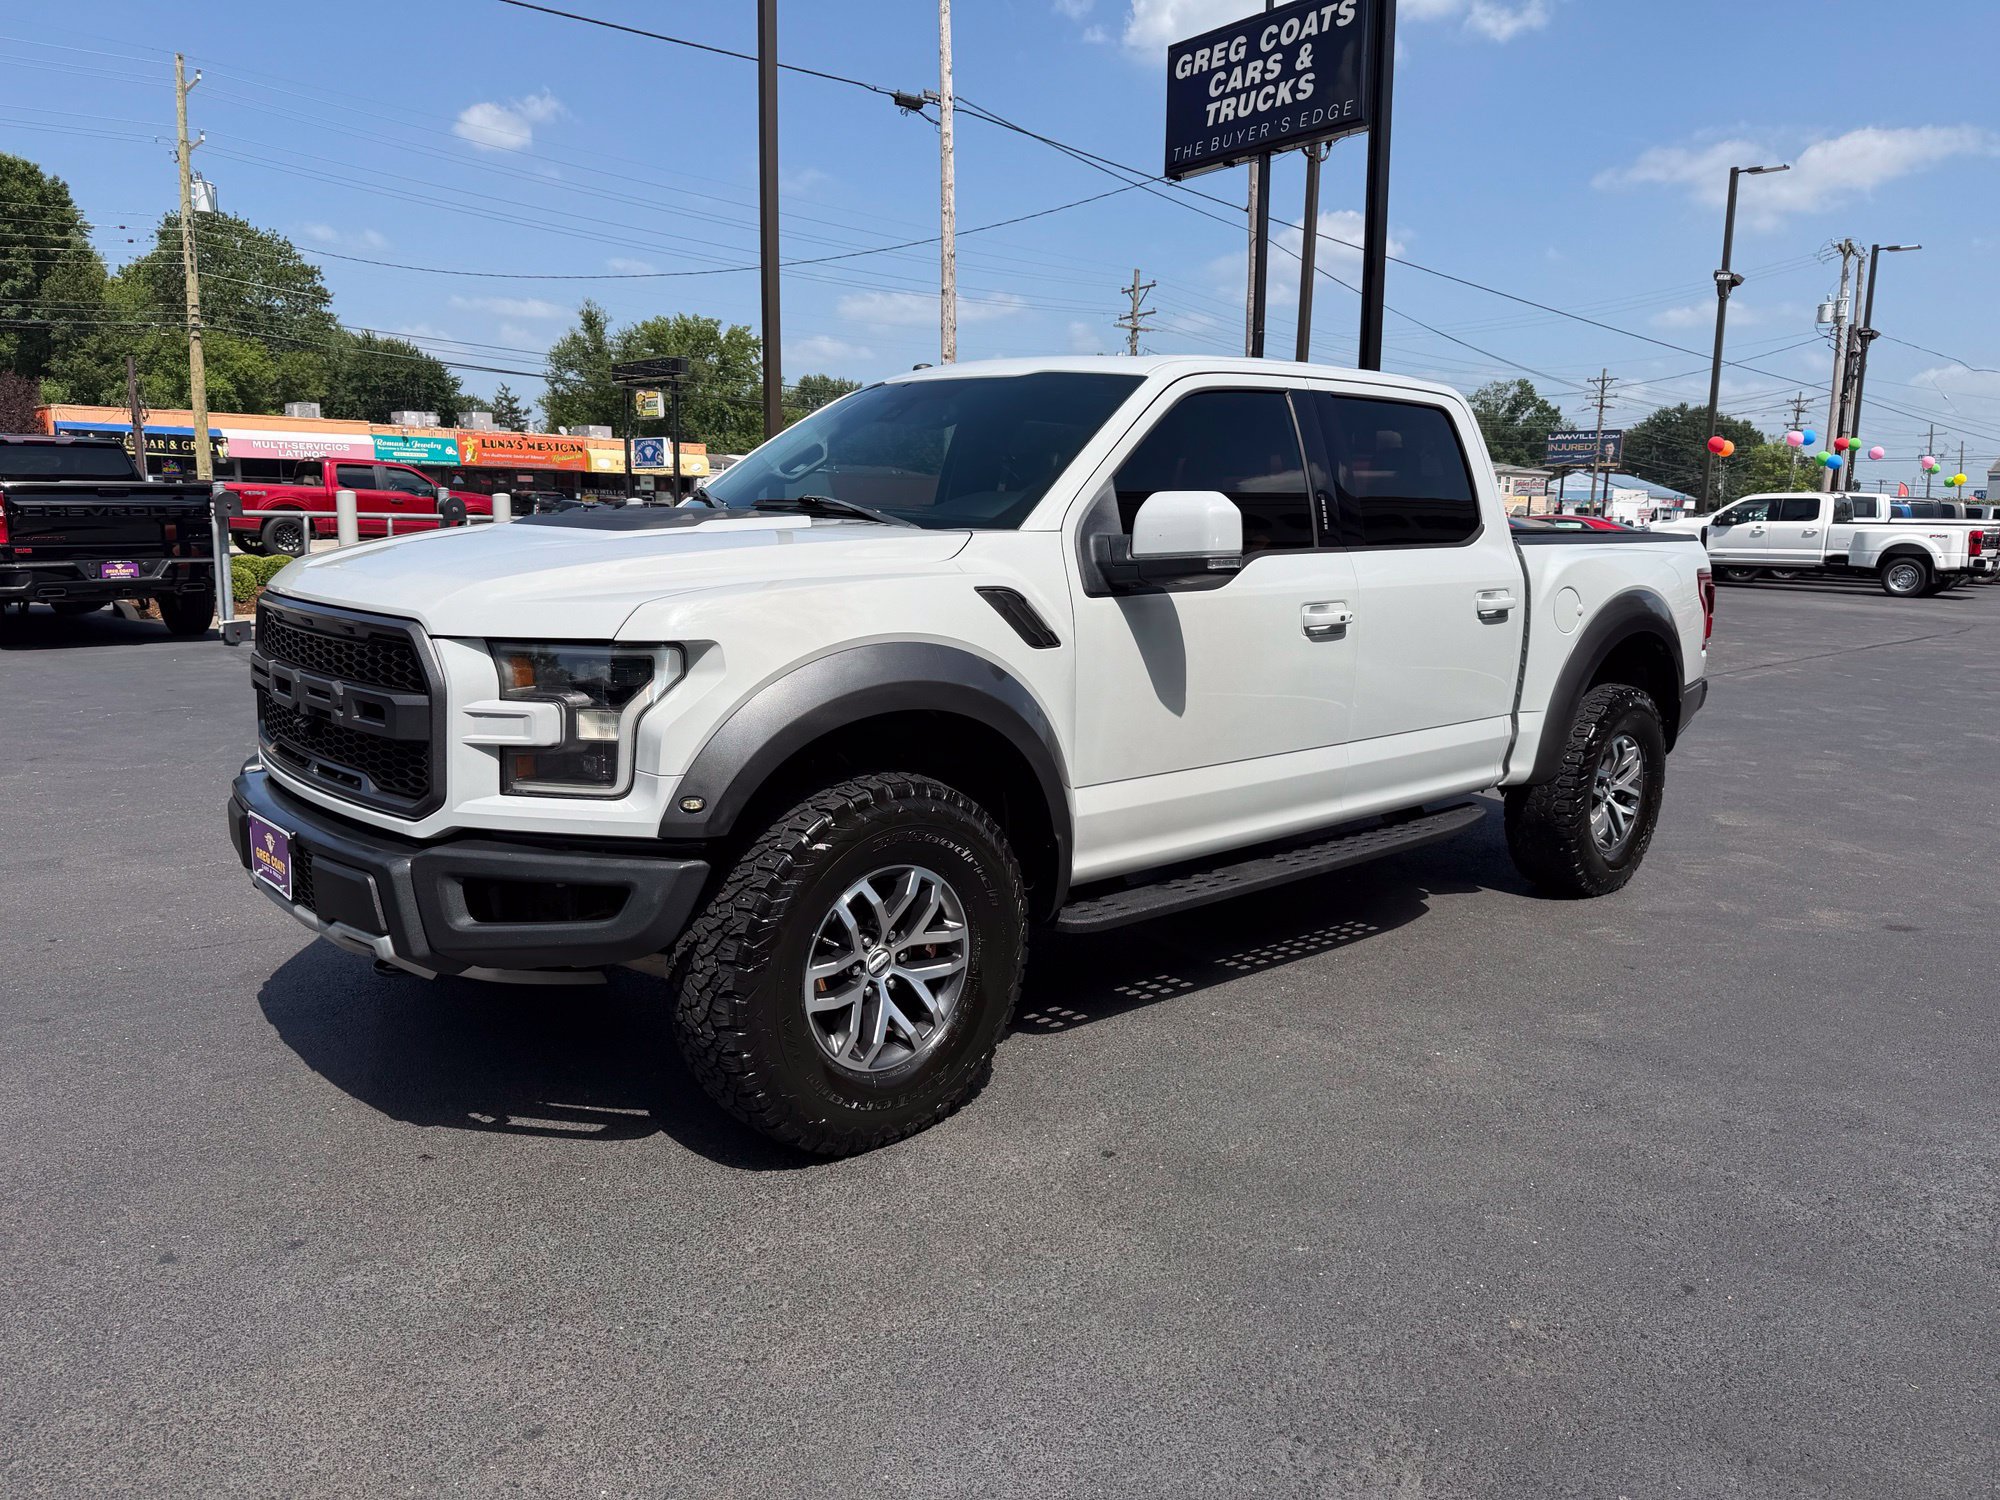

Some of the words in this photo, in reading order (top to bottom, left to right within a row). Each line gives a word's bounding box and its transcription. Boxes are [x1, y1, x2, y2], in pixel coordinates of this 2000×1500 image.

[1175, 35, 1247, 80] GREG
[1259, 0, 1357, 52] COATS
[1208, 52, 1284, 98] CARS
[1295, 43, 1314, 71] &
[1205, 72, 1316, 127] TRUCKS
[1173, 140, 1204, 162] THE
[1210, 117, 1291, 152] BUYER'S
[1299, 100, 1354, 128] EDGE
[169, 440, 178, 449] &
[252, 440, 350, 451] MULTI-SERVICIOS
[278, 449, 327, 458] LATINOS
[411, 440, 442, 450] Jewelry
[481, 438, 523, 450] LUNA'S
[527, 442, 584, 453] MEXICAN
[24, 507, 207, 517] CHEVROLET
[251, 650, 397, 736] FORD
[256, 846, 270, 864] GREG
[271, 855, 286, 875] COATS
